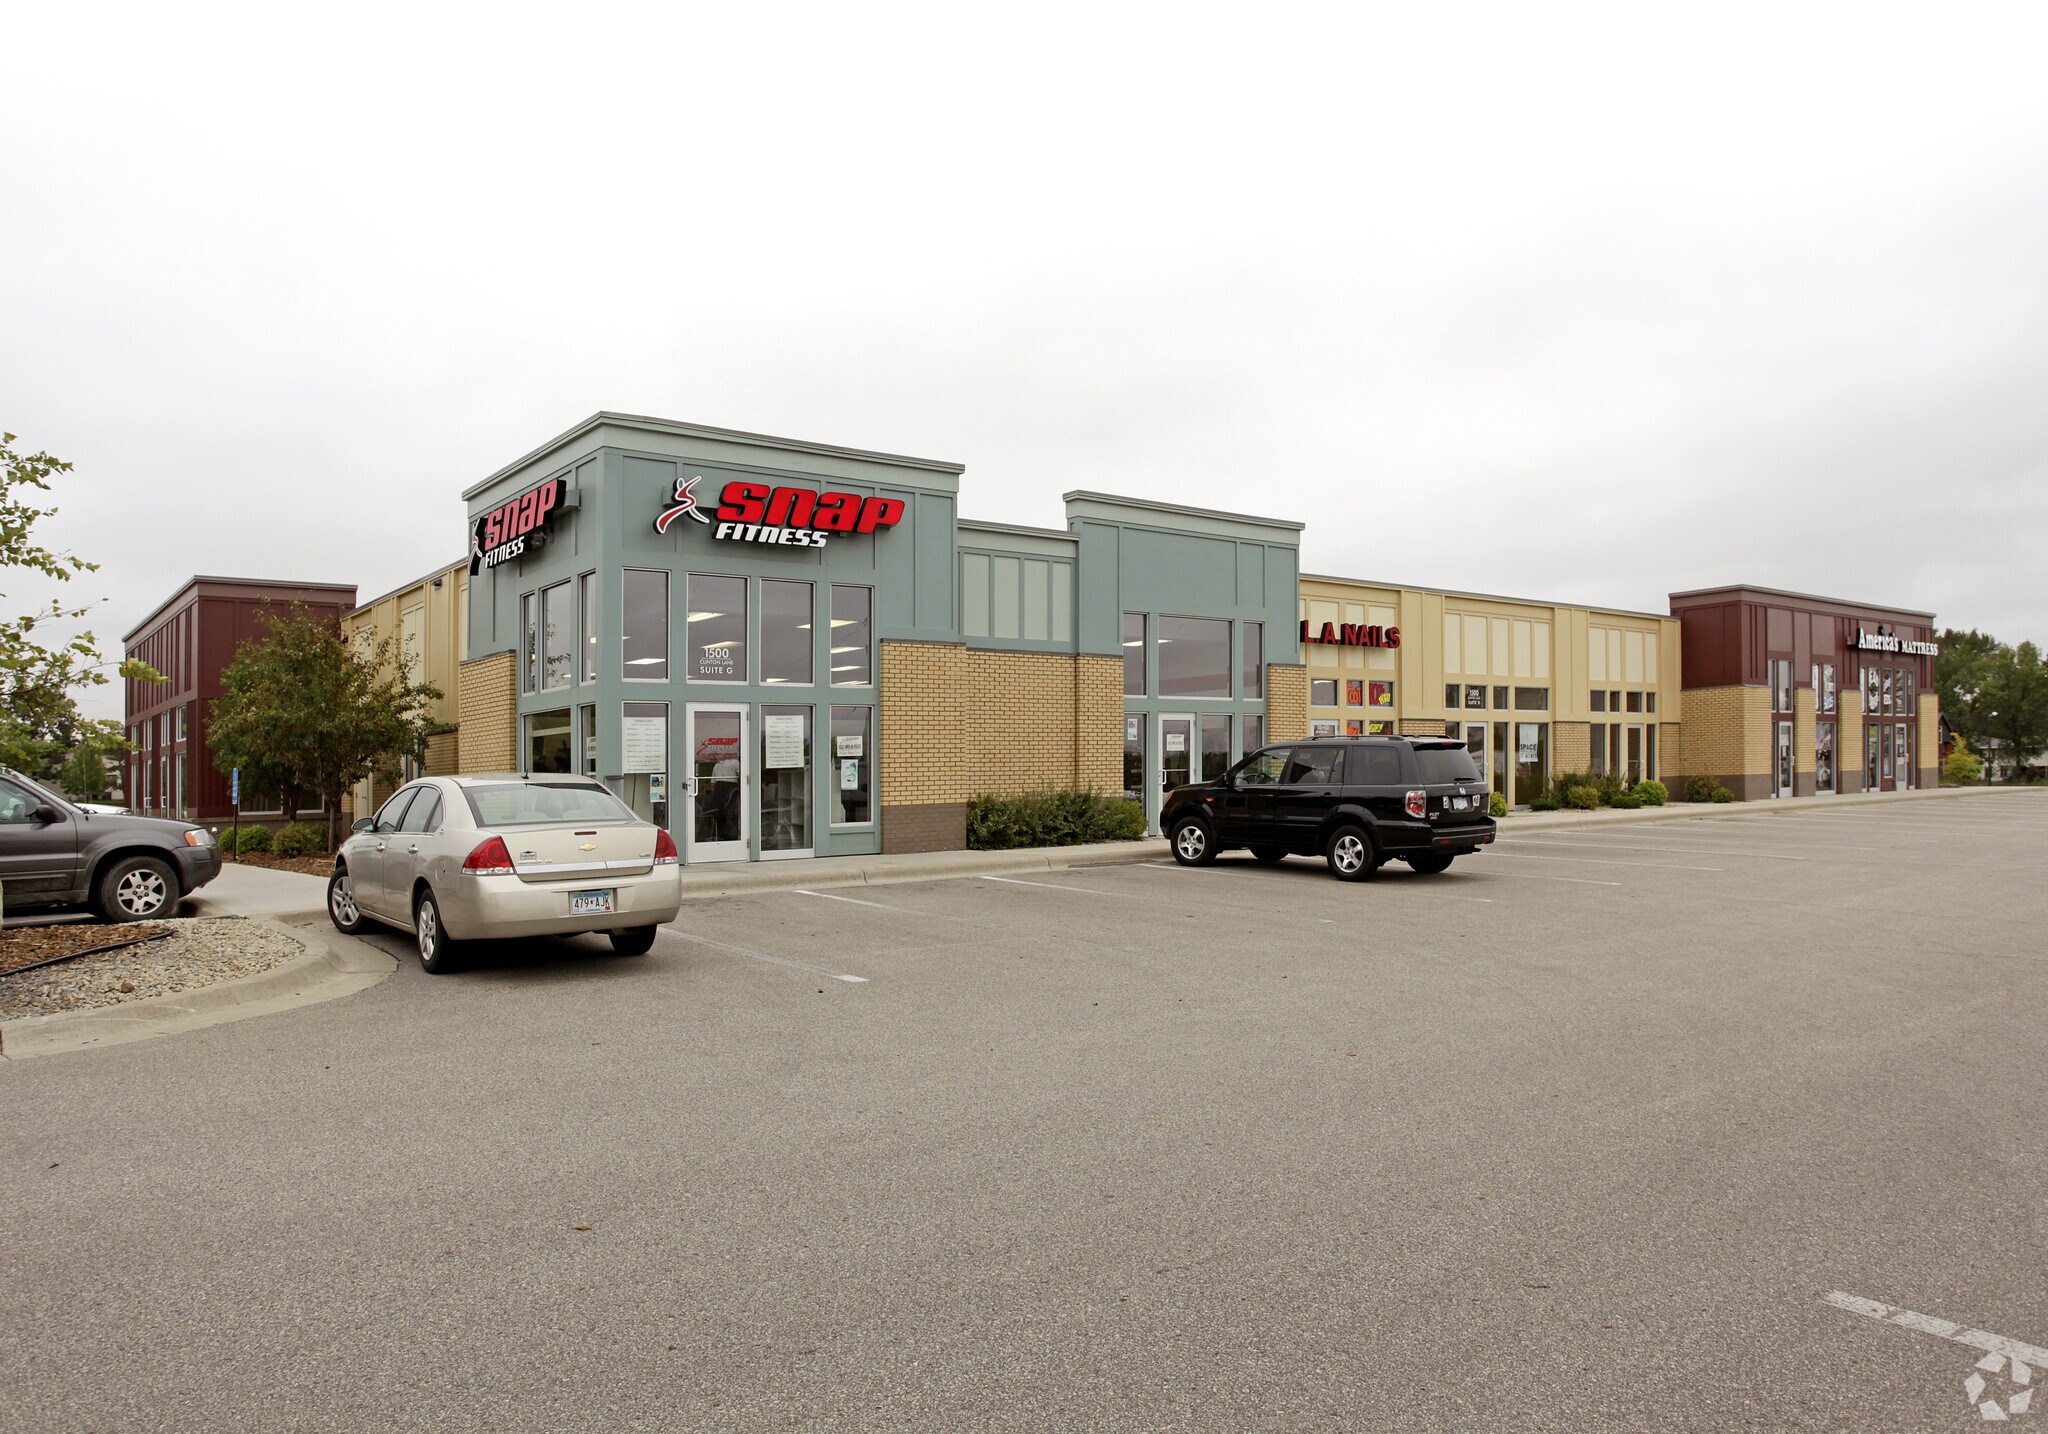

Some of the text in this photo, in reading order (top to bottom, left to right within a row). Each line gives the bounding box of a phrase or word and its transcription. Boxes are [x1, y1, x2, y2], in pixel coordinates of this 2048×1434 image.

[715, 522, 829, 548] FITNESS
[484, 535, 525, 569] FITNESS
[1342, 623, 1401, 649] NAILS
[1858, 627, 1939, 656] America's MATTRESS
[704, 648, 729, 659] 1500
[700, 666, 723, 674] SUITE
[1520, 743, 1537, 751] SPACE
[575, 896, 610, 908] 479 AJK
